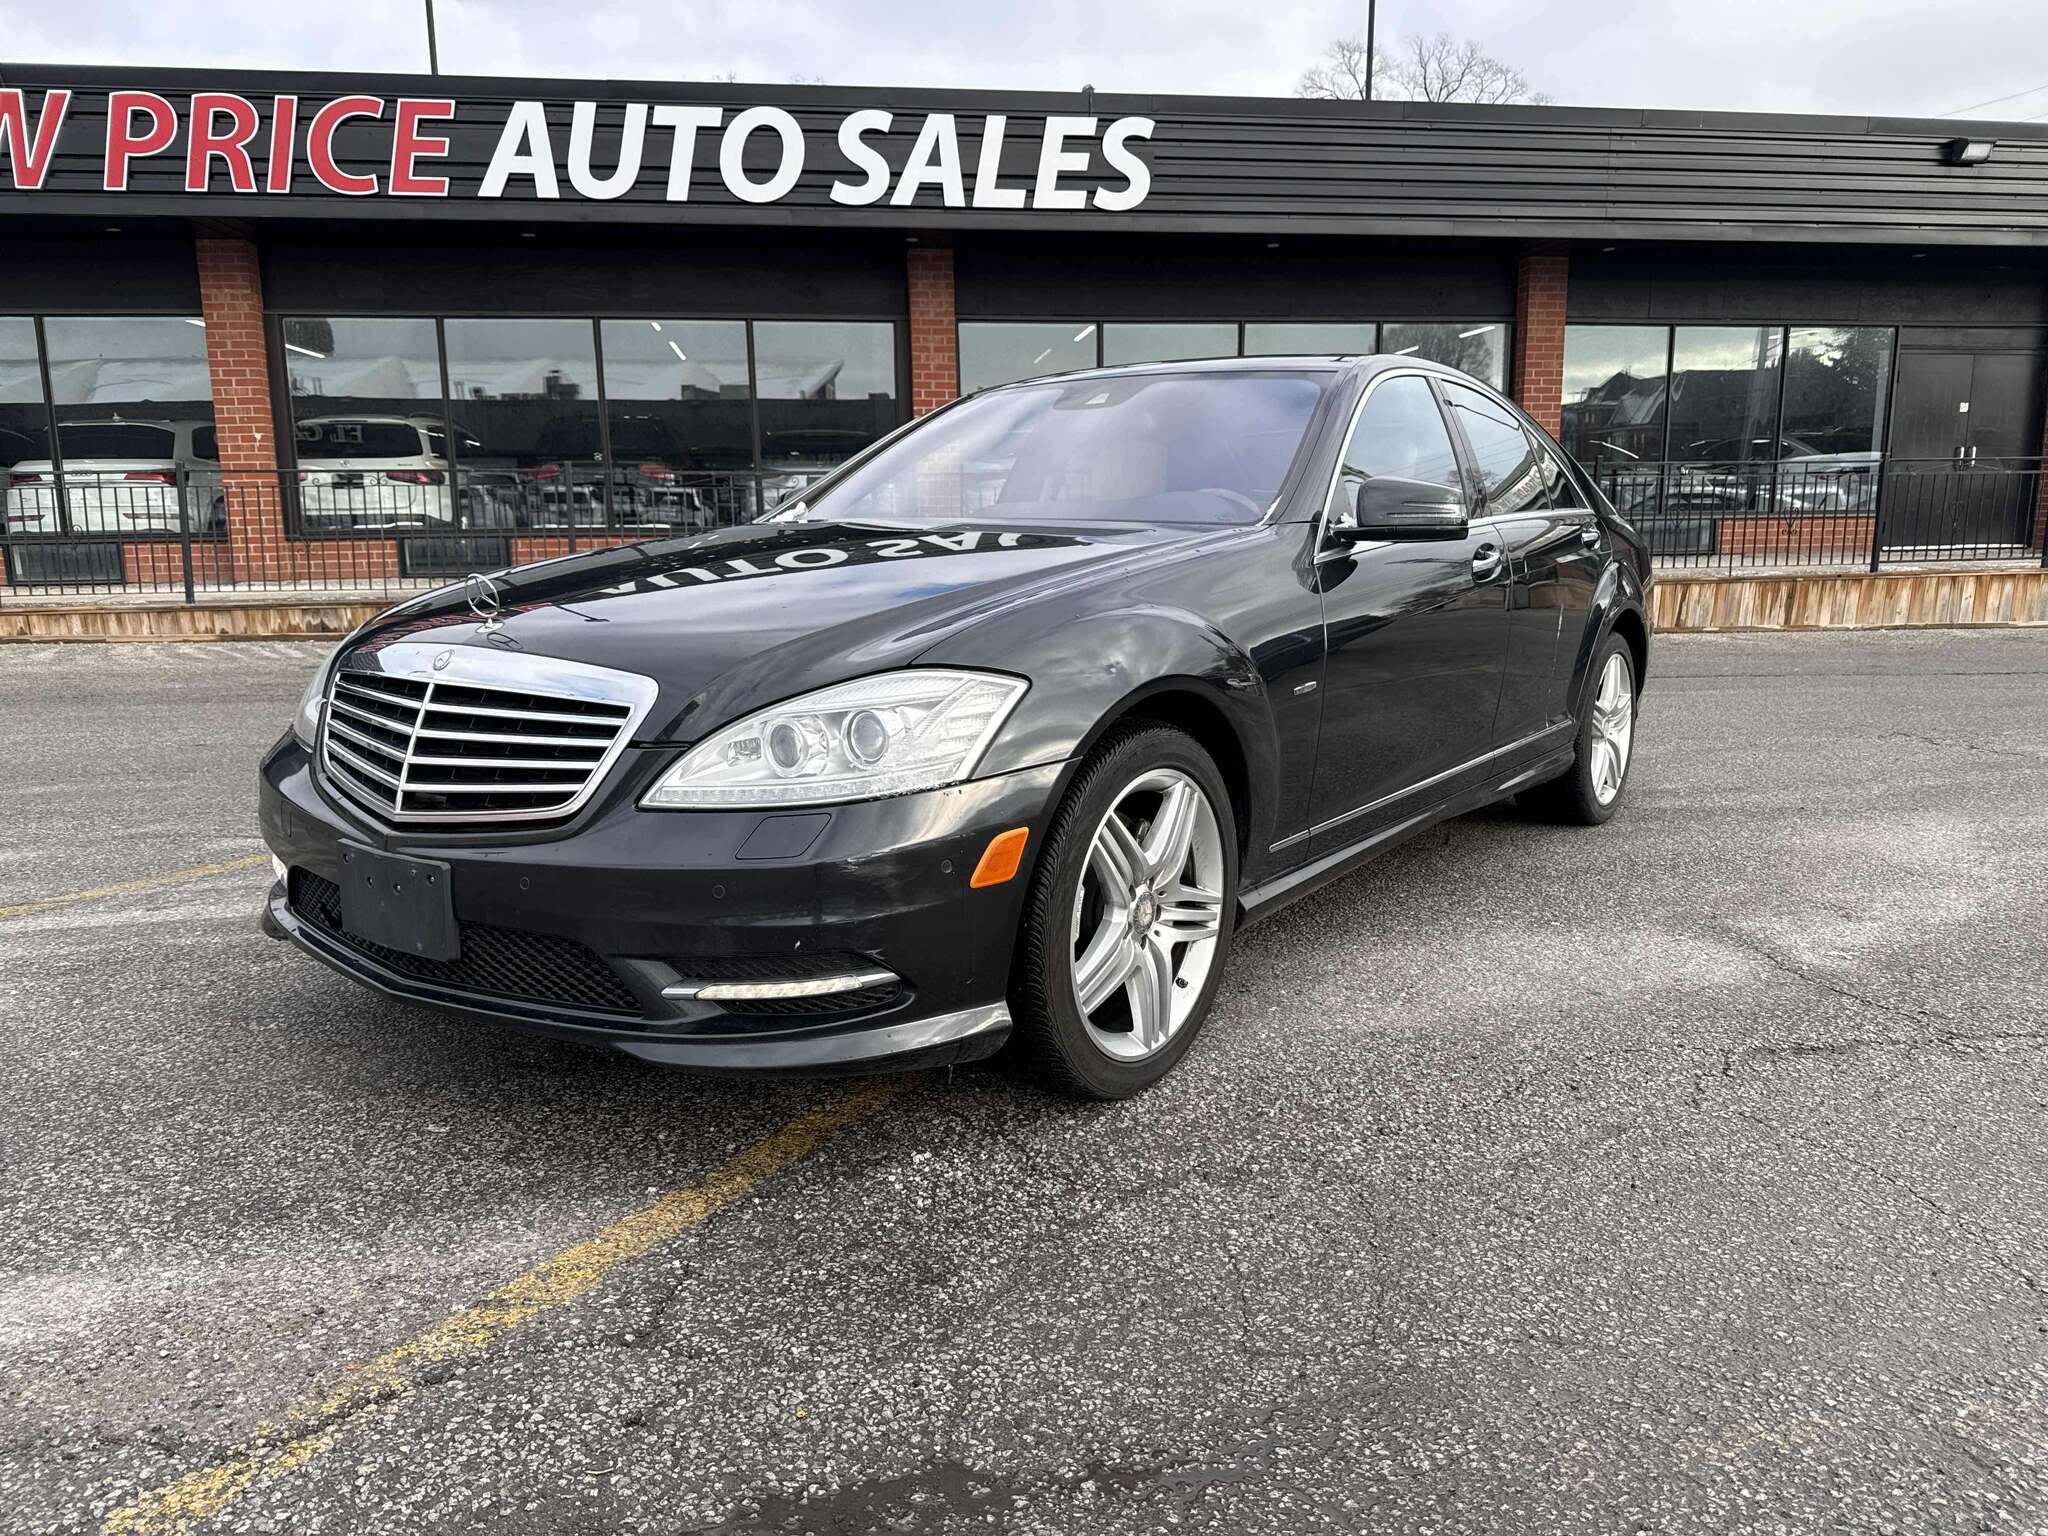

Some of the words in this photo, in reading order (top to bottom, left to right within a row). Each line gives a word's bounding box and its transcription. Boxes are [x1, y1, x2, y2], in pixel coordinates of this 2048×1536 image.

[103, 90, 456, 199] PRICE
[478, 101, 805, 205] AUTO
[829, 109, 1156, 211] SALES
